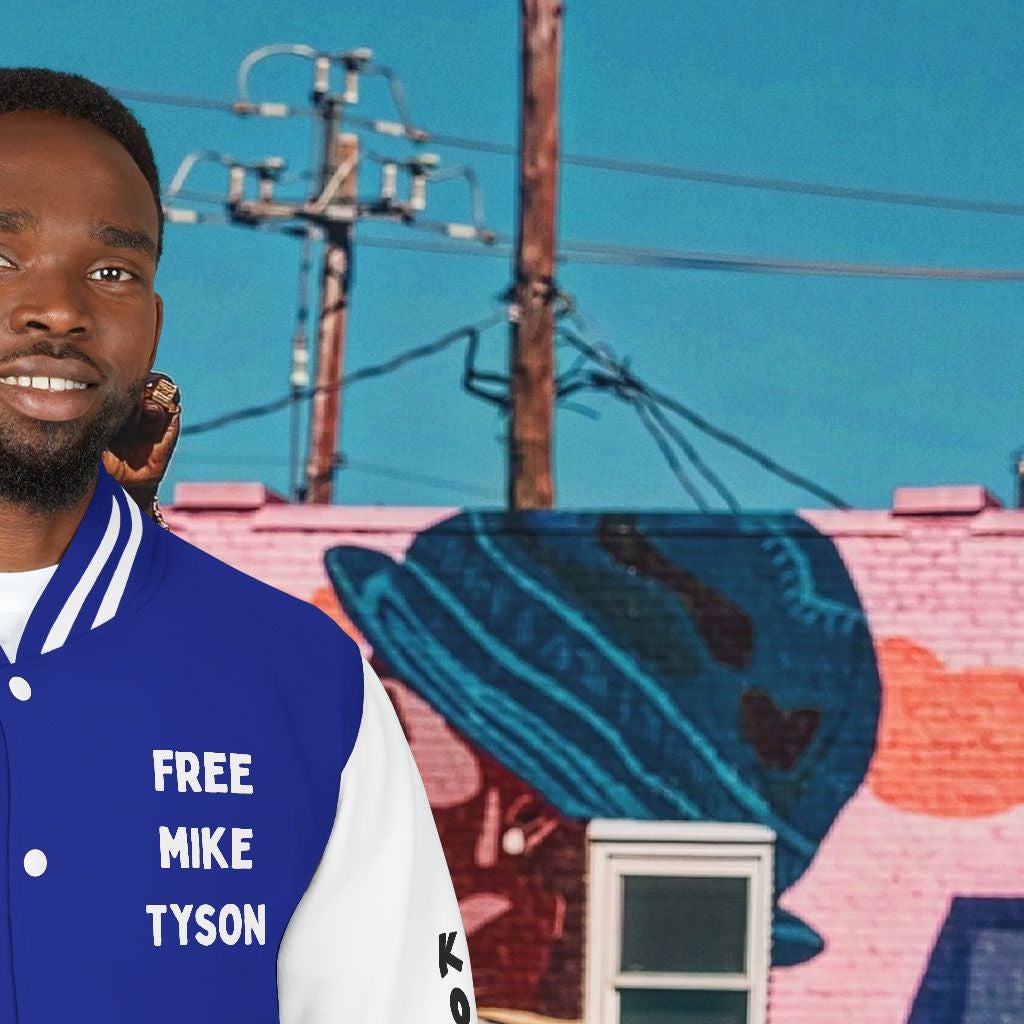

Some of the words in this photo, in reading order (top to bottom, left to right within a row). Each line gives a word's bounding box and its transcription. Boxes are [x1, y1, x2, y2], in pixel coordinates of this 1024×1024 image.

[152, 749, 254, 795] FREE
[158, 825, 254, 870] MIKE
[145, 903, 266, 947] TYSON
